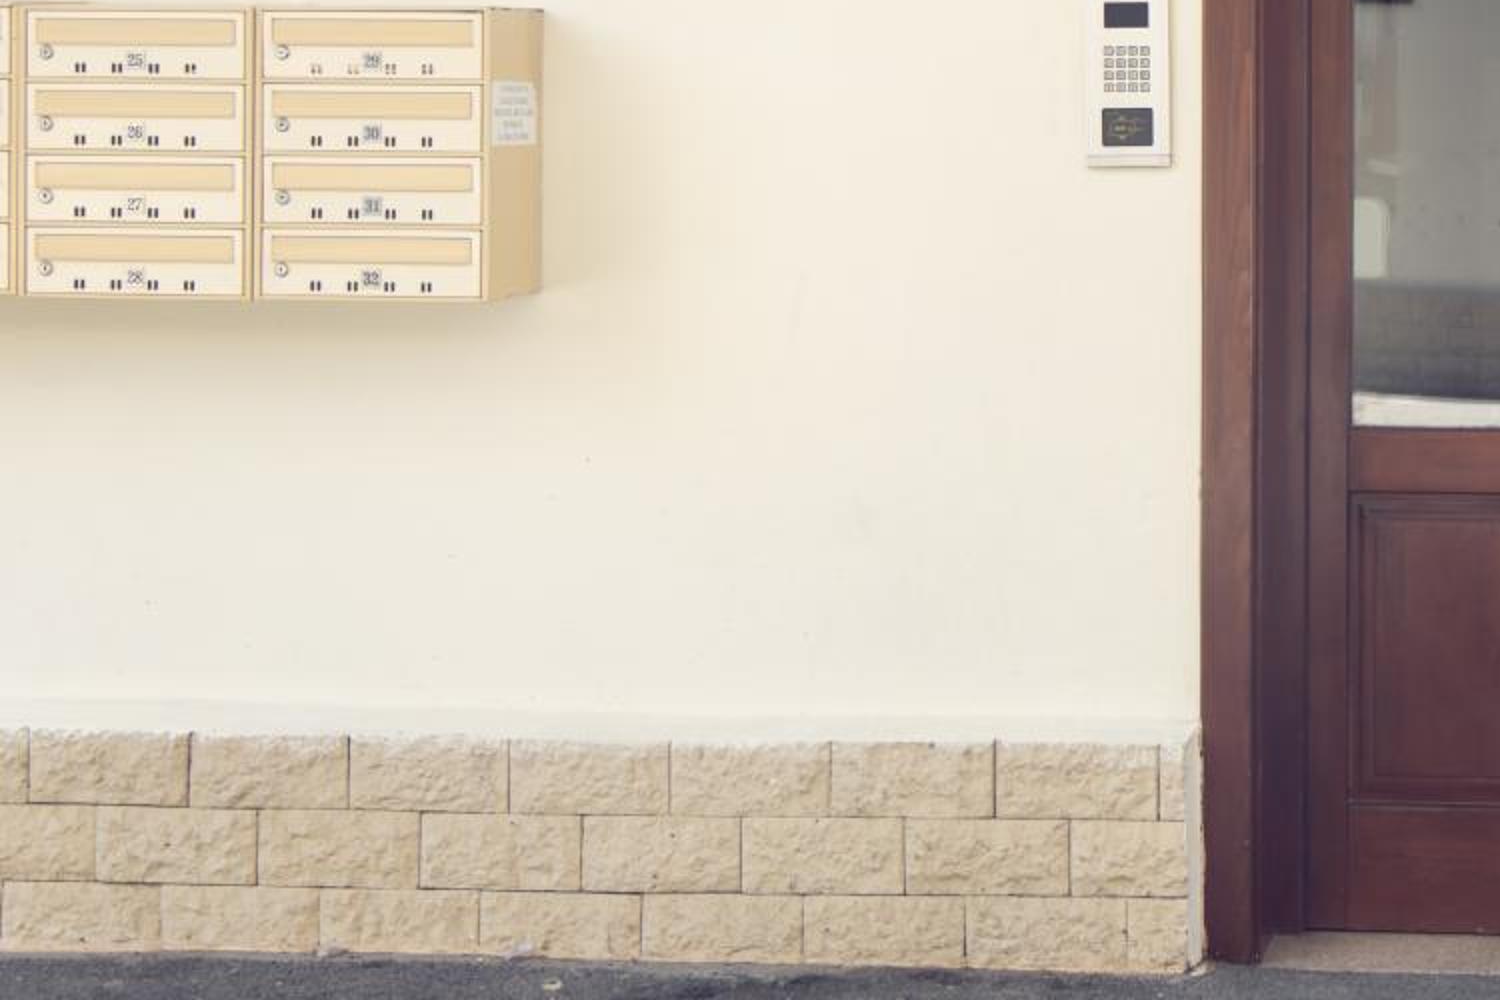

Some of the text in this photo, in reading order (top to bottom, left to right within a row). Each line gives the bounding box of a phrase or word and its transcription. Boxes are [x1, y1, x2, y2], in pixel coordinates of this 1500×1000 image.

[127, 53, 144, 67] 25
[127, 197, 144, 211] 27
[363, 271, 380, 285] 32
